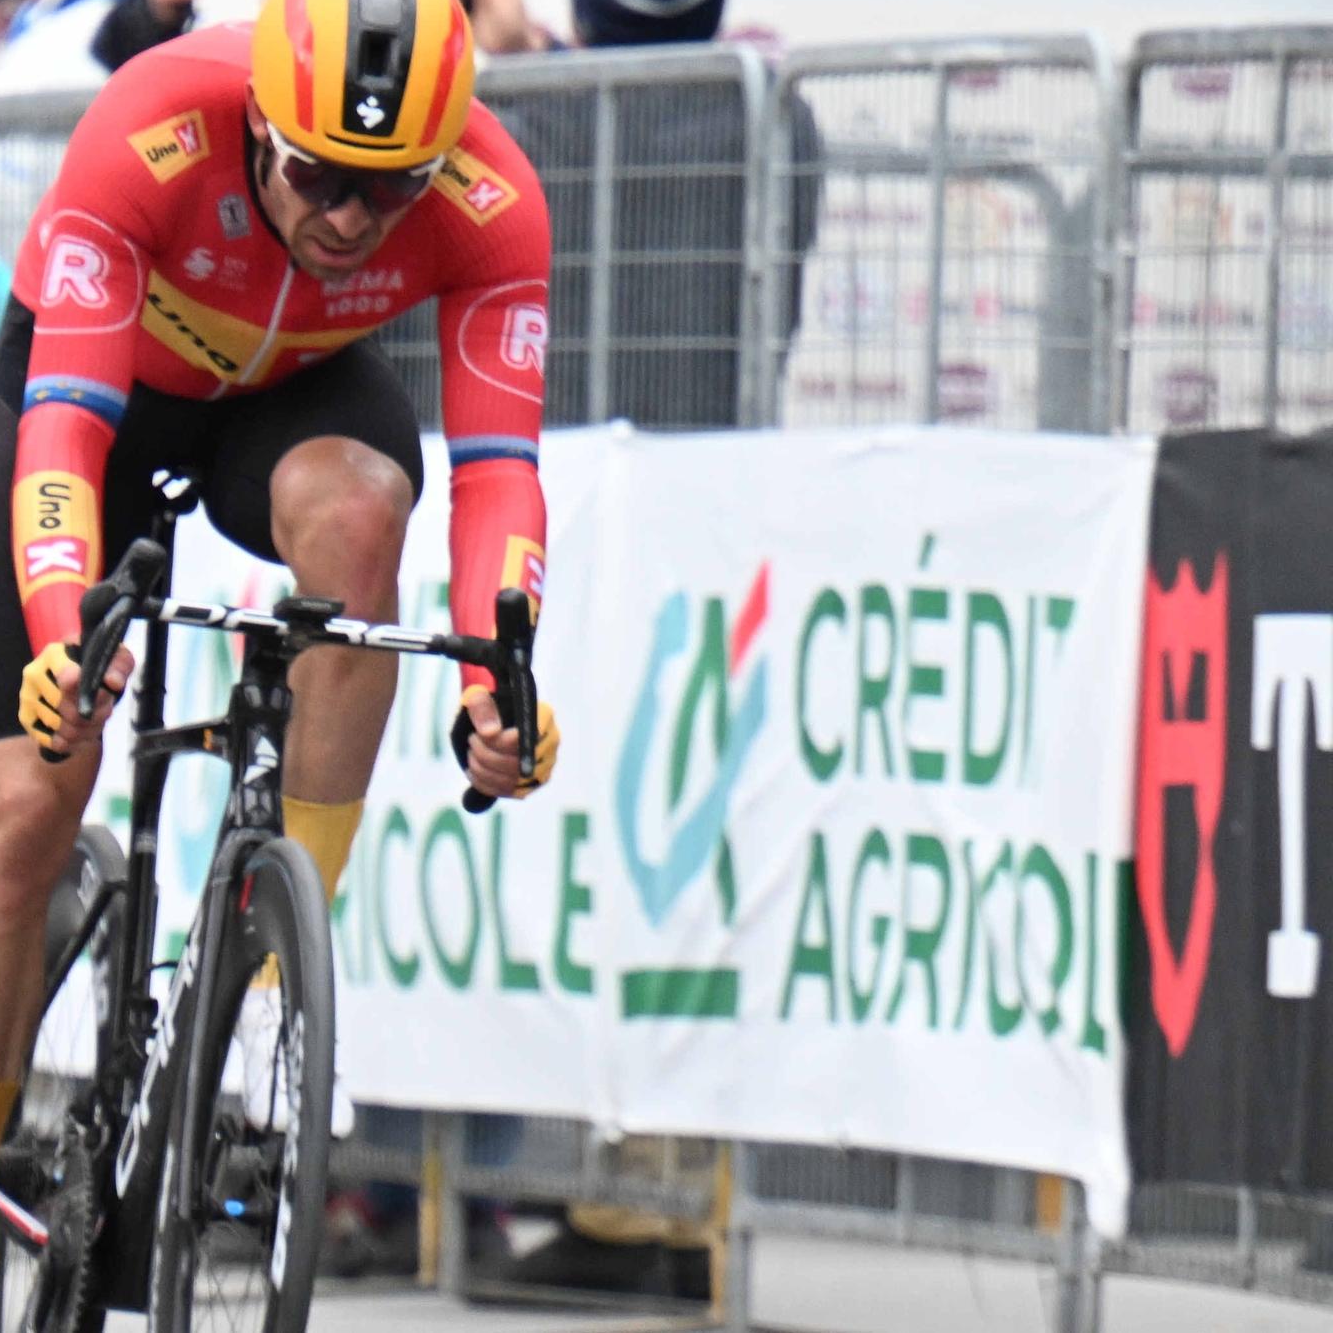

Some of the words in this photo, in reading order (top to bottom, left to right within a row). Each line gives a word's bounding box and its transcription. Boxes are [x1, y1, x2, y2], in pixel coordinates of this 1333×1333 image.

[146, 143, 179, 164] Uno
[38, 482, 71, 530] Uno
[795, 532, 1077, 787] CRÉDIT
[779, 827, 1109, 1055] AGRICOL
